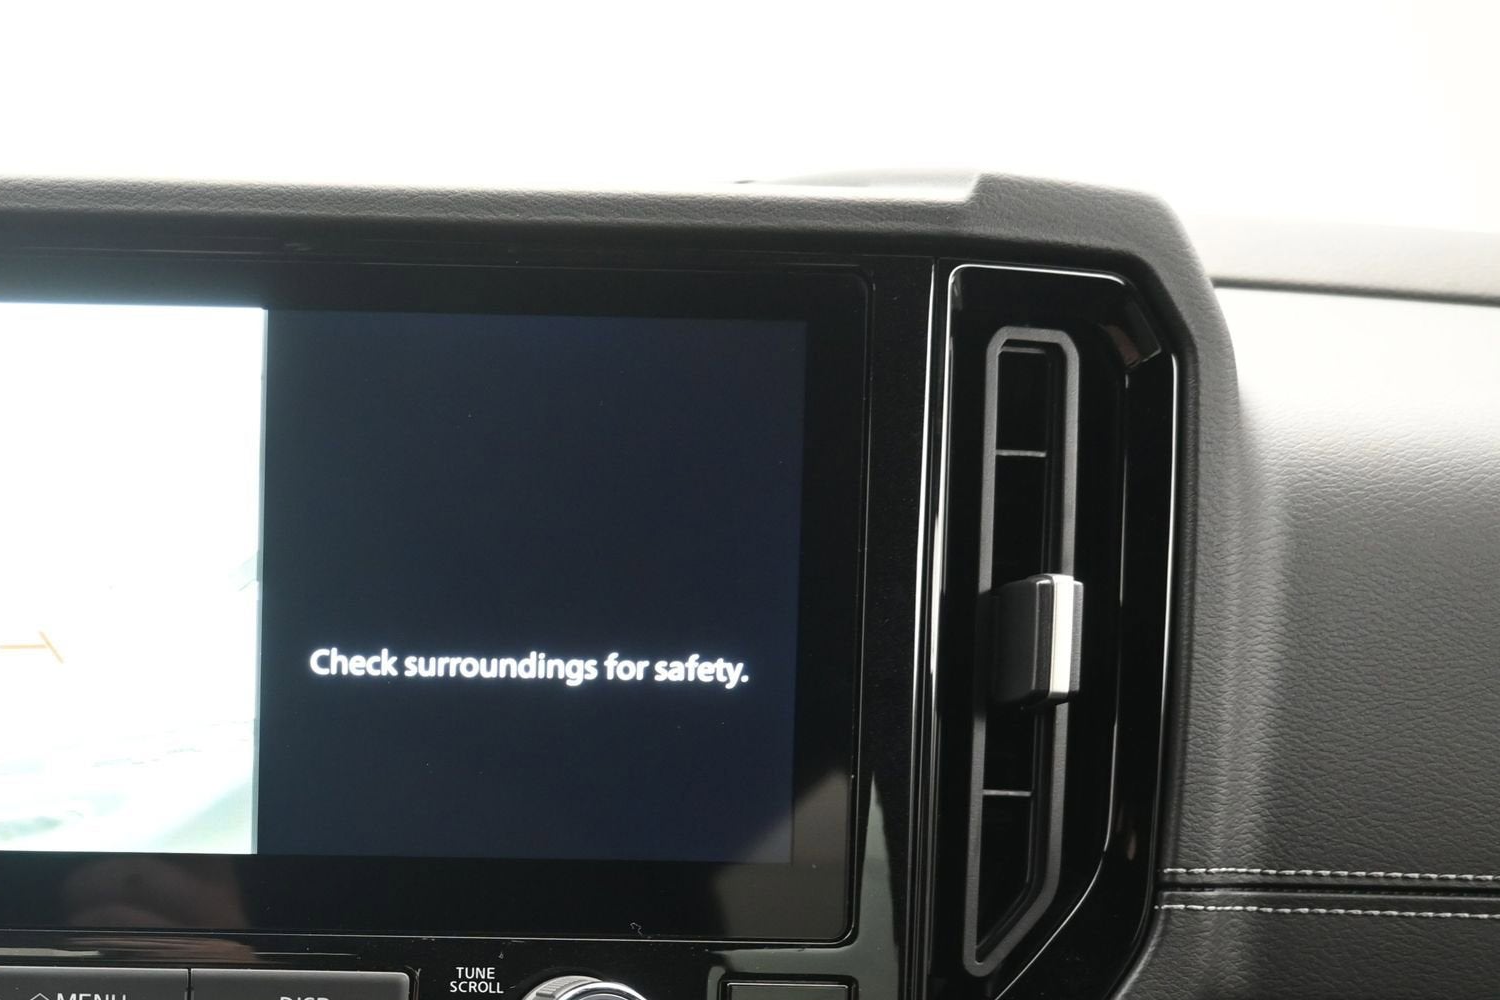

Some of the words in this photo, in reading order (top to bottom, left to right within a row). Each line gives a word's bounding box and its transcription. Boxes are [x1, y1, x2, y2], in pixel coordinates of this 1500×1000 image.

[309, 647, 398, 677] Check
[404, 652, 599, 687] surroundings
[603, 653, 650, 681] for
[653, 654, 750, 690] safety.
[456, 966, 496, 980] TUNE
[449, 981, 504, 995] SCROLL
